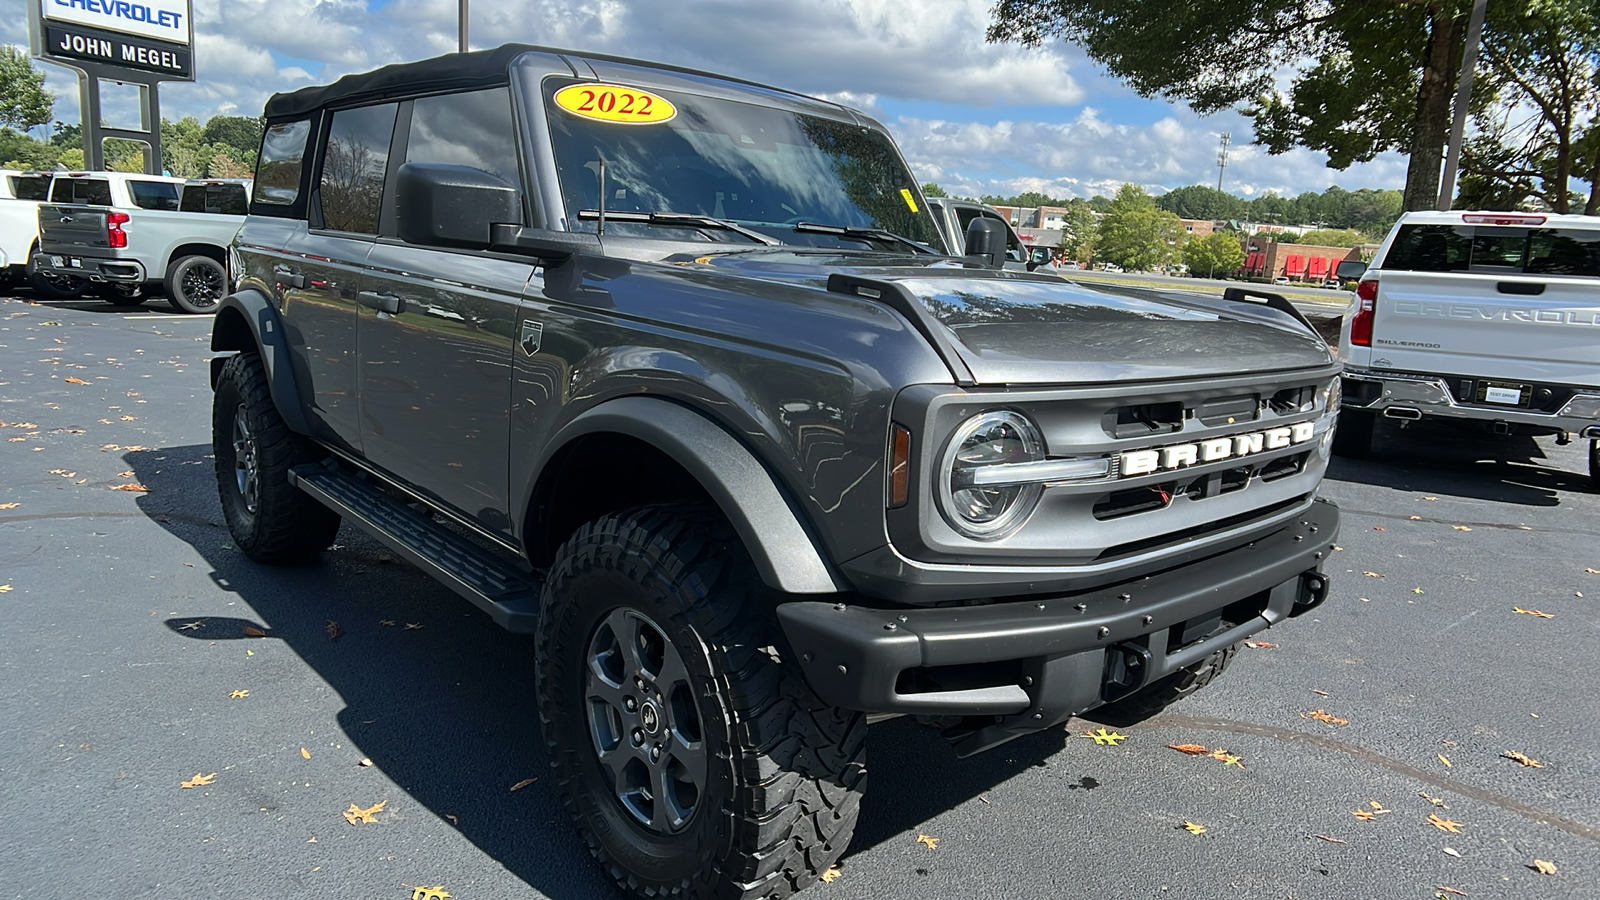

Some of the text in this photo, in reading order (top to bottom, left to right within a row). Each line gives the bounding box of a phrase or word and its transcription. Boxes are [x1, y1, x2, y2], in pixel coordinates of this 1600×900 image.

[60, 34, 182, 69] JOHN MEGEL
[577, 90, 653, 115] 2022
[1377, 339, 1441, 349] SILVERADO
[1120, 420, 1315, 476] BRONCO
